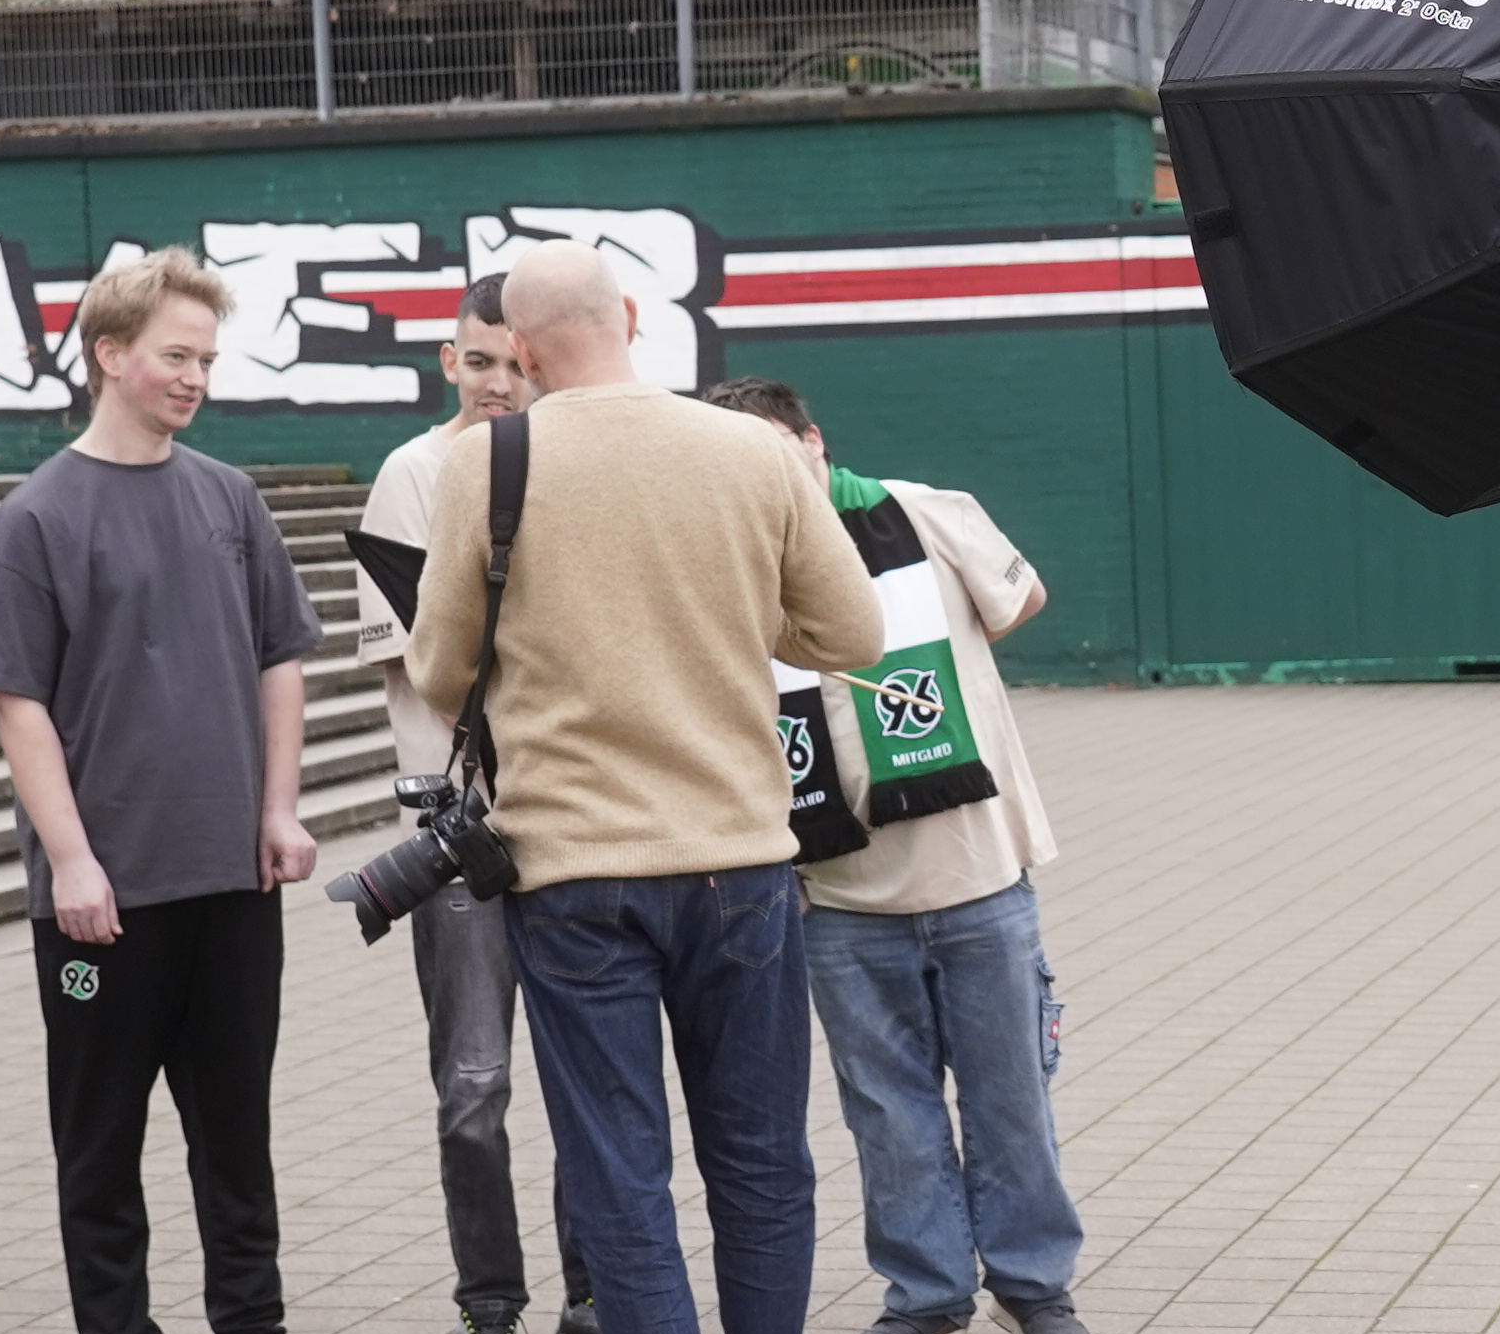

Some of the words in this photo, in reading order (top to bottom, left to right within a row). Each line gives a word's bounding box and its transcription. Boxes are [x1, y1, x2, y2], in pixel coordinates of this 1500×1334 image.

[1420, 2, 1473, 30] Octa
[878, 673, 939, 734] 96
[891, 742, 952, 767] MITGLIED
[63, 966, 96, 994] 96
